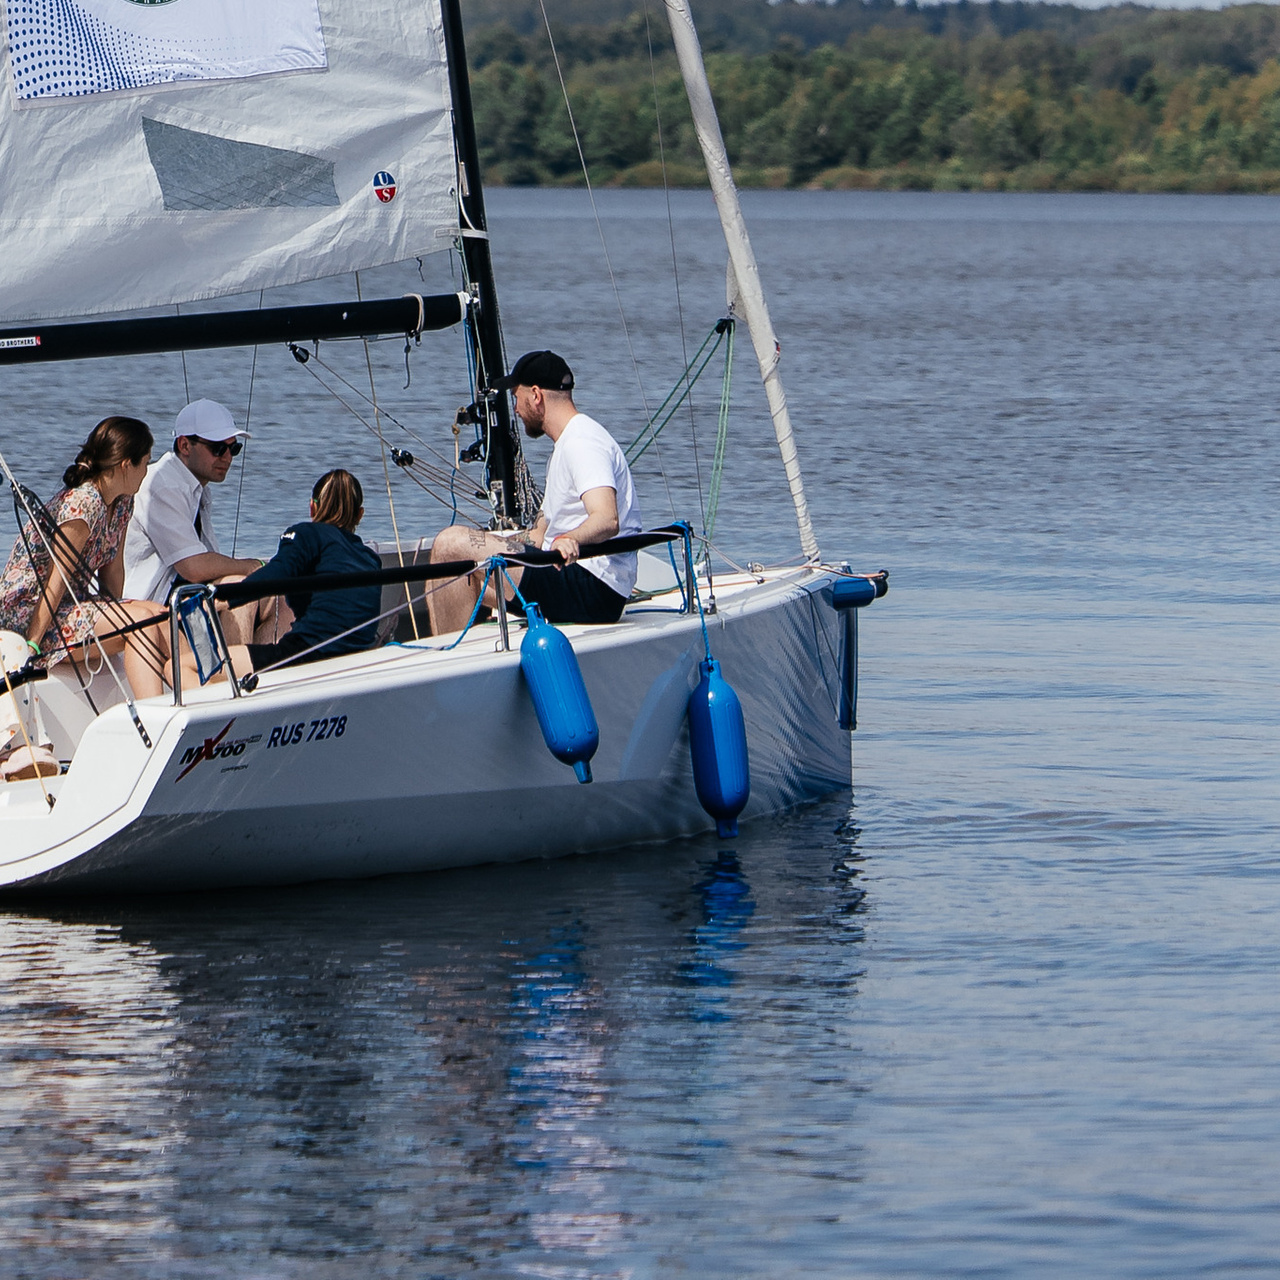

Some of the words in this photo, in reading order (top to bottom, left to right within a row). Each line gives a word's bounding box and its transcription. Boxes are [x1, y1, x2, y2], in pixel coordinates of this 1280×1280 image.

[175, 717, 247, 784] MX700
[267, 722, 305, 749] RUS
[306, 715, 348, 743] 7278
